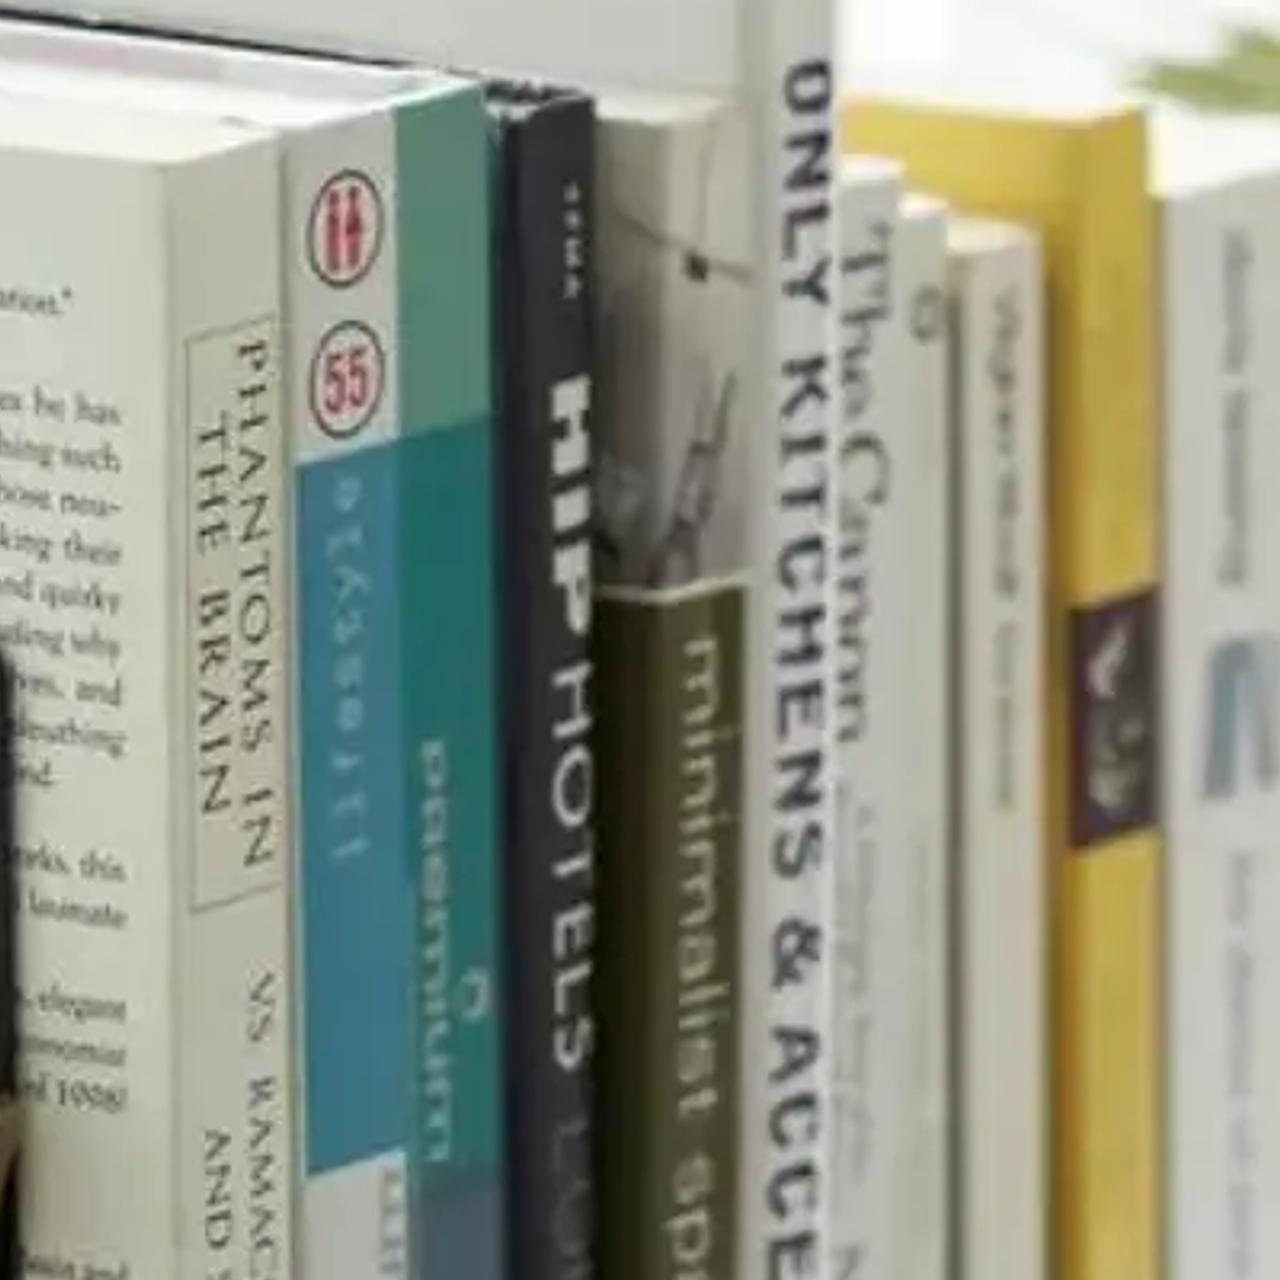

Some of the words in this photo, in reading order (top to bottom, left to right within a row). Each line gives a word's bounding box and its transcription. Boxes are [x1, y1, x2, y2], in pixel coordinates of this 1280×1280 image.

[784, 60, 834, 306] ONLY
[33, 383, 65, 418] he
[75, 389, 121, 426] has
[837, 220, 893, 419] The
[60, 443, 121, 474] such
[63, 529, 121, 566] their
[195, 410, 229, 555] THE
[237, 340, 274, 755] PHANTOMS
[551, 372, 591, 637] HIP
[39, 578, 121, 620] quirky
[326, 474, 372, 861] lifestyle
[774, 357, 830, 881] KITCHENS
[198, 589, 232, 817] BRAIN
[242, 787, 278, 872] IN
[551, 662, 595, 1074] HOTELS
[677, 638, 732, 1120] minimalist
[769, 917, 823, 995] &
[204, 1128, 232, 1251] AND
